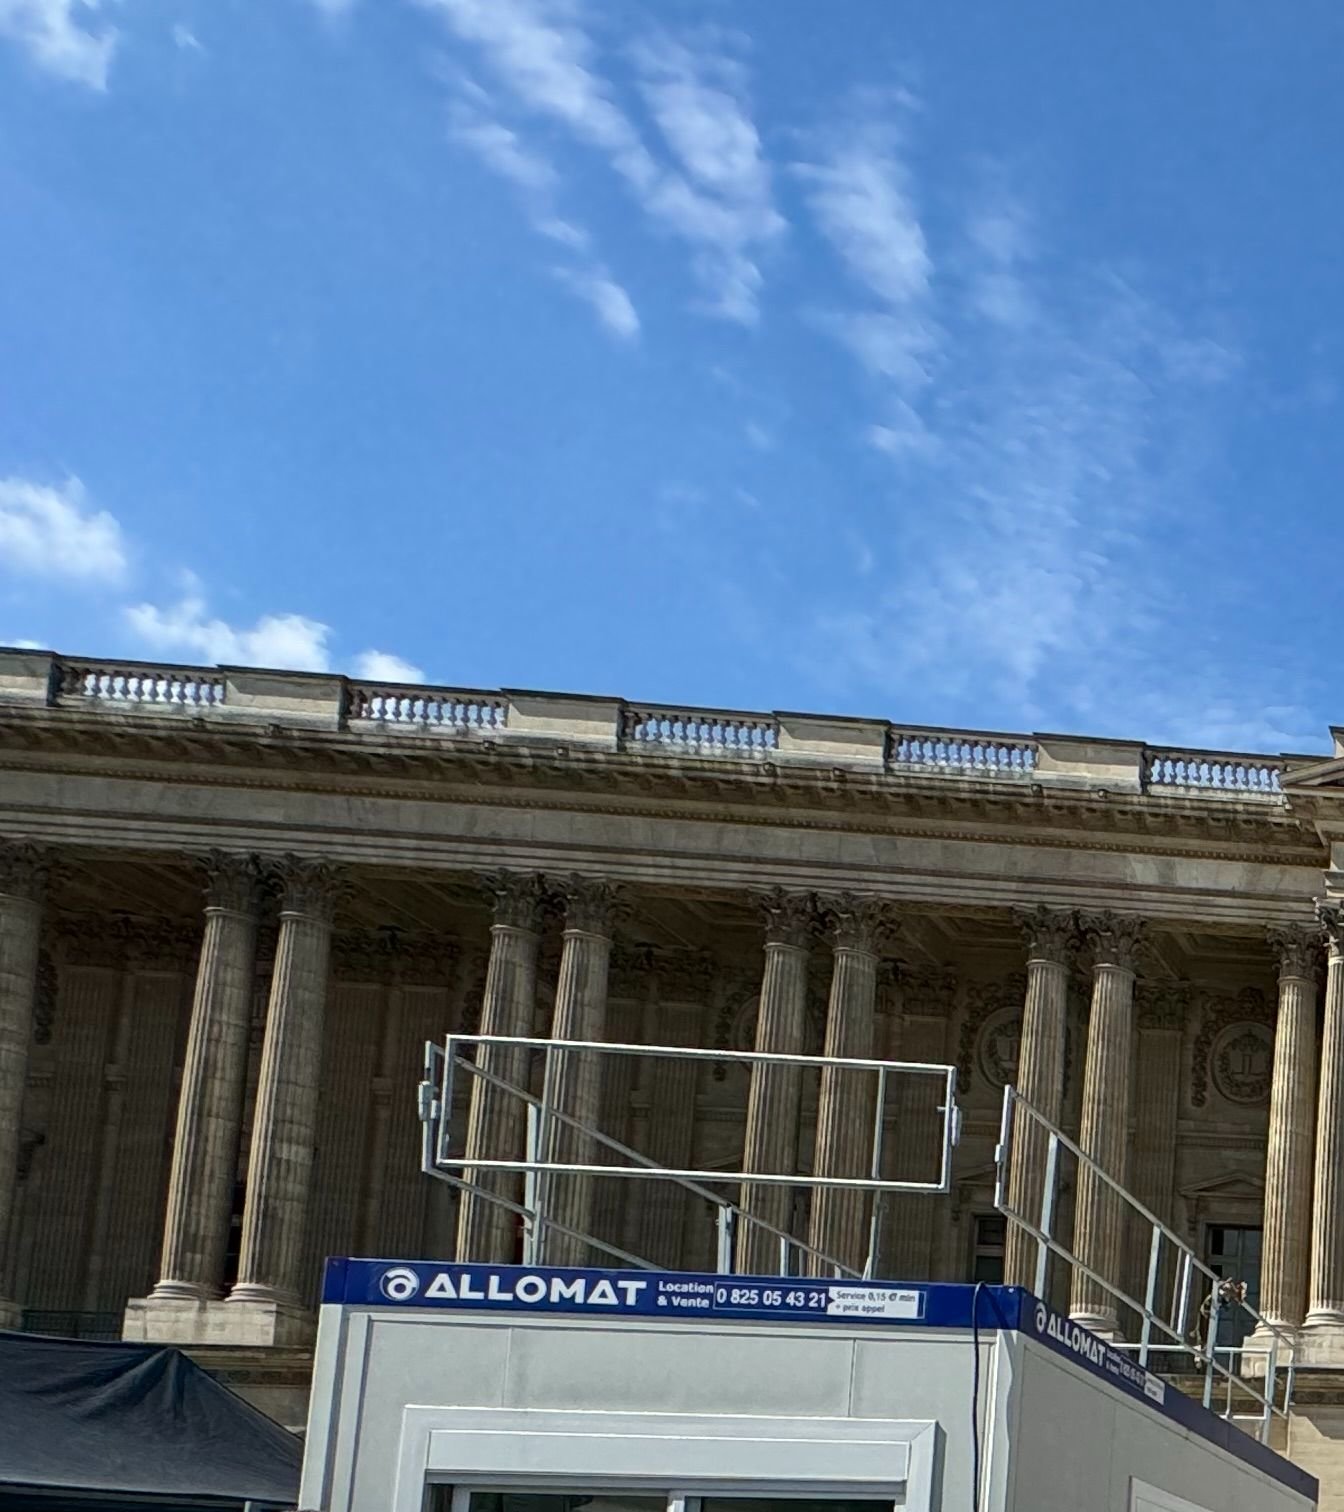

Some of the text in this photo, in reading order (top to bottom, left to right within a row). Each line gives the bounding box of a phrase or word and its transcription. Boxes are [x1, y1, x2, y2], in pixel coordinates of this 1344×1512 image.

[424, 1273, 647, 1306] ALLOMAT
[658, 1280, 714, 1293] Location
[657, 1295, 710, 1308] & Vente
[717, 1288, 826, 1308] 0 825 05 43 21
[836, 1291, 866, 1300] Service
[842, 1304, 859, 1312] prix
[862, 1305, 885, 1313] appel
[1047, 1312, 1106, 1366] ALLOMAT
